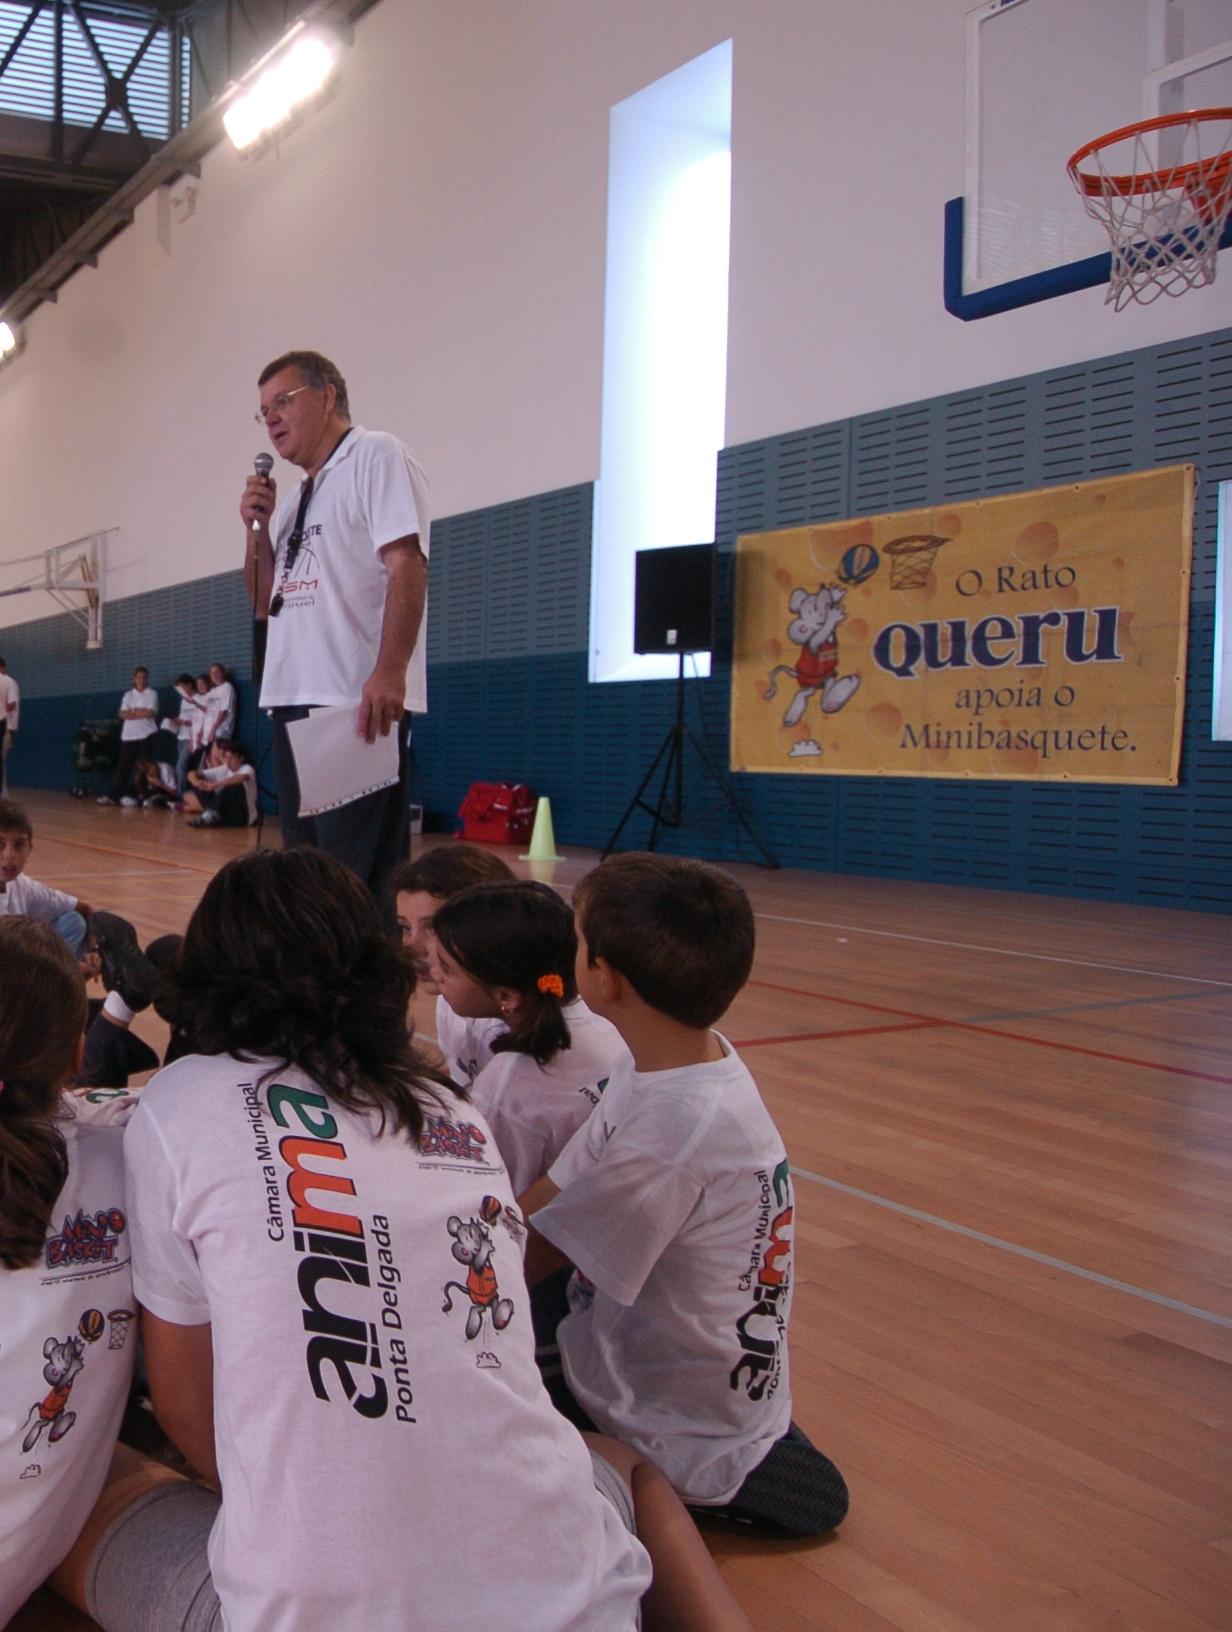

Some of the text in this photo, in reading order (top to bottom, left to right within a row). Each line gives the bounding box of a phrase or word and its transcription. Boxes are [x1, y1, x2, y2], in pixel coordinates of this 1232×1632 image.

[955, 563, 1076, 597] O Rato
[900, 721, 1137, 759] Minibasquete.
[955, 679, 1075, 716] apoia o
[237, 1082, 284, 1242] Câmara Municipal
[266, 1083, 388, 1418] anima
[371, 1214, 417, 1424] Ponta Delgada
